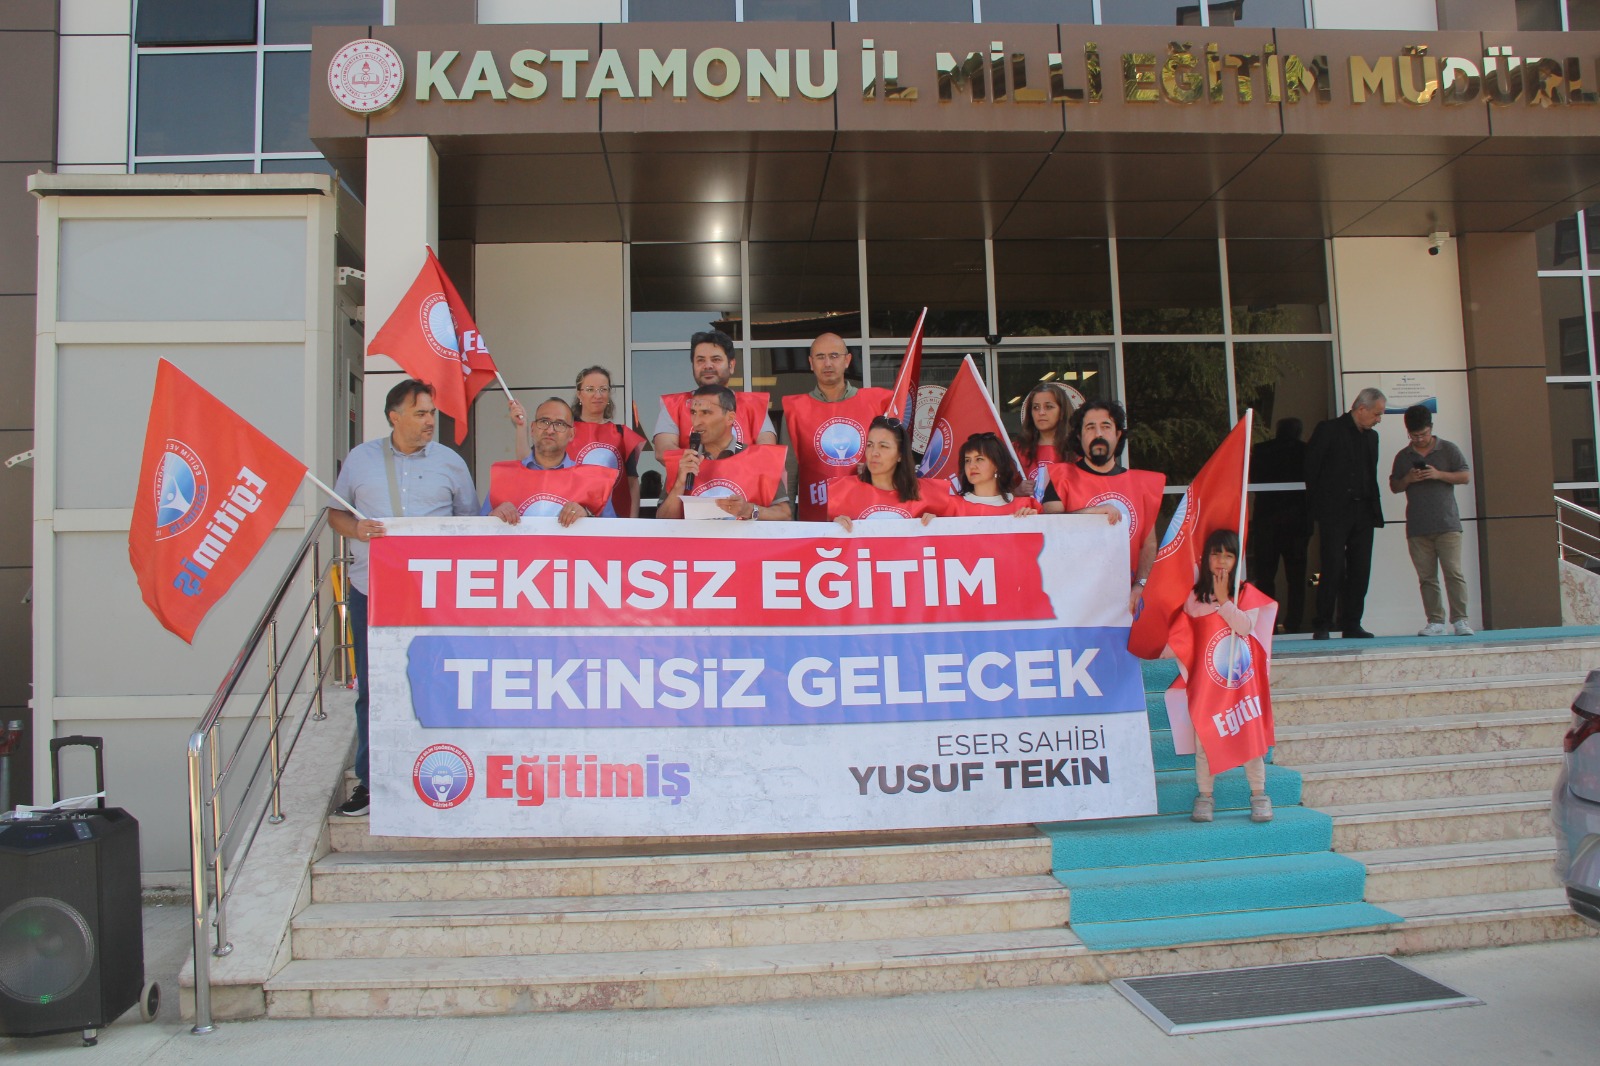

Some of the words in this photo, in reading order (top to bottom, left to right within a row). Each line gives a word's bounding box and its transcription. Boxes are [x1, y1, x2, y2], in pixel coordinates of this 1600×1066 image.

[414, 46, 840, 102] KASTAMONU
[861, 38, 918, 100] İL
[936, 40, 1103, 102] MİLLİ
[1122, 41, 1332, 103] EĞİTİM
[1348, 45, 1600, 107] MÜDÜRL
[761, 546, 998, 611] EĞİTİM
[787, 648, 1104, 708] GELECEK
[936, 733, 1010, 757] ESER
[1017, 725, 1107, 754] SAHİBİ
[486, 753, 692, 808] Eğitimiş
[848, 761, 984, 797] YUSUF
